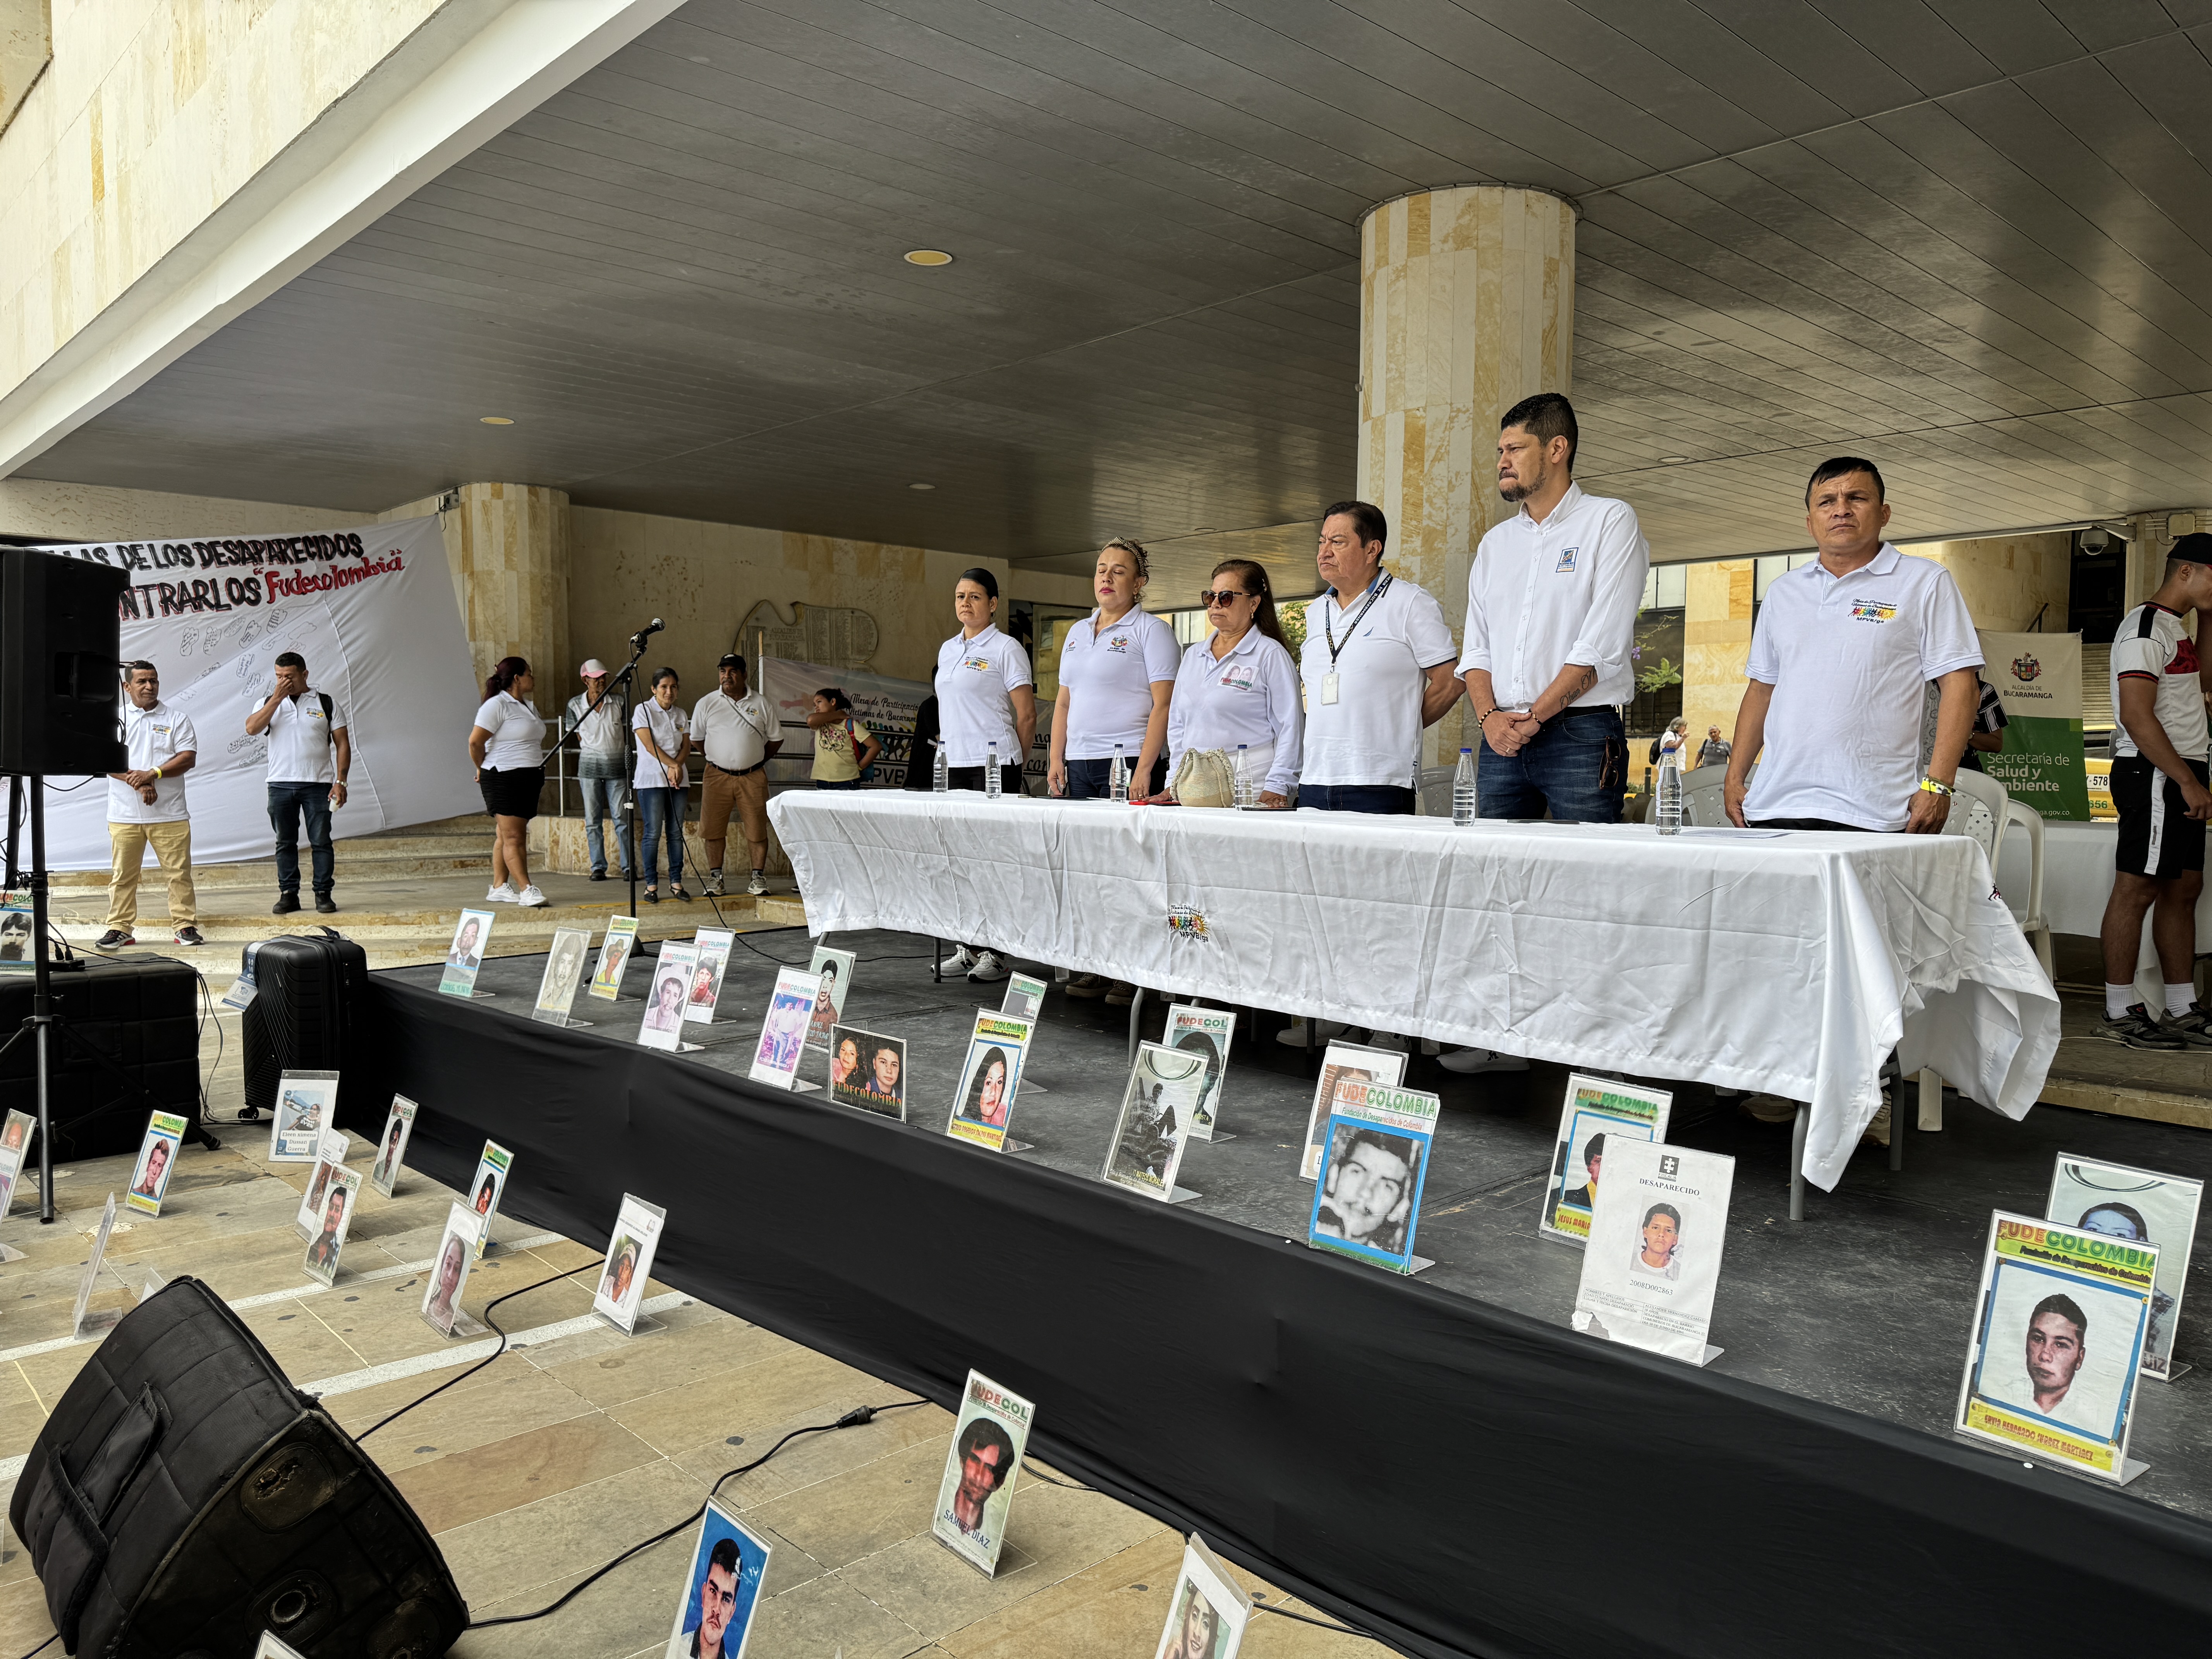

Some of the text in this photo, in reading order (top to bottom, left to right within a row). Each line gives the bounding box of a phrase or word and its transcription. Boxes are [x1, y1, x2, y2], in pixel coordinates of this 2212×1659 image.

[115, 544, 152, 571] DE
[147, 543, 196, 569] LOS
[193, 532, 364, 570] DESAPARECIDOS
[851, 694, 869, 705] Mesa
[871, 696, 879, 706] de
[2004, 690, 2052, 699] BUCARAMANGA
[876, 709, 884, 719] de
[1987, 752, 2070, 766] Secretaría de
[1987, 764, 2041, 780] Salud y
[2093, 776, 2108, 786] 578
[778, 982, 816, 995] FUDECOLOMBIA
[979, 1018, 1027, 1033] FUDECOLOMBIA
[833, 1080, 902, 1108] FUDECOLOMBIA
[1335, 1082, 1437, 1118] FUDECOLOMBIA
[1342, 1107, 1362, 1118] Fundación
[1368, 1113, 1397, 1125] Desaparecidos
[1403, 1119, 1422, 1131] Colombia
[1137, 1170, 1149, 1182] MATEOS
[1149, 1175, 1164, 1187] MORALES
[1640, 1178, 1700, 1196] DESAPARECIDO
[1558, 1214, 1591, 1230] JESUS MARIA
[1997, 1219, 2156, 1270] FUDECOLOMBIA
[2108, 1266, 2118, 1276] de
[2118, 1269, 2152, 1284] Colombia
[1629, 1279, 1673, 1295] 2008D002863
[1645, 1304, 1667, 1313] ALEXANDER
[1668, 1310, 1690, 1318] HERNANDEZ
[1642, 1316, 1666, 1325] COMUNEROS
[1671, 1324, 1700, 1335] BUCARAMANGA
[986, 1403, 1006, 1417] Desaparecidos
[1011, 1416, 1025, 1428] Colombia
[944, 1509, 970, 1536] SAMUEL
[971, 1529, 991, 1549] DIAZ
